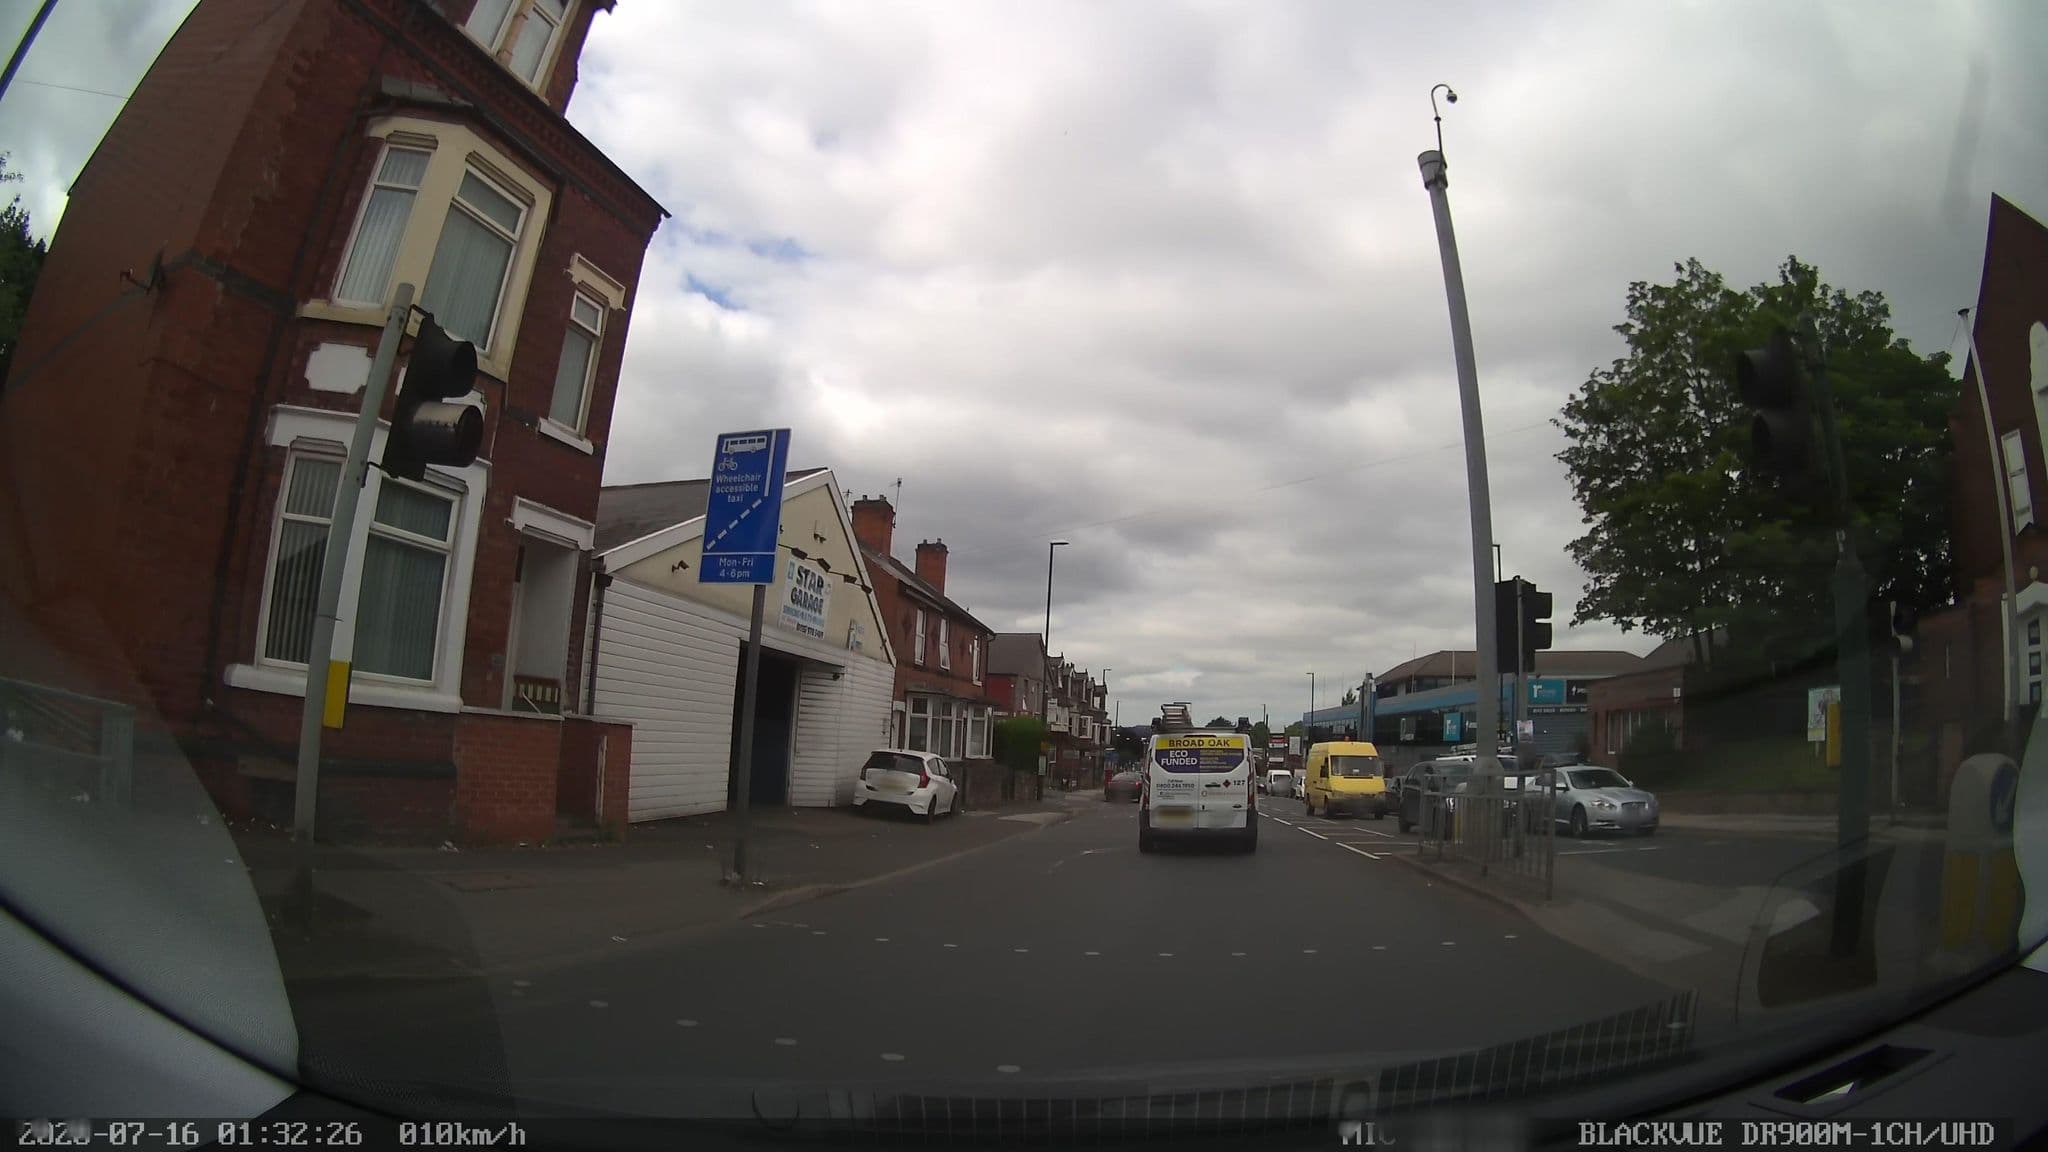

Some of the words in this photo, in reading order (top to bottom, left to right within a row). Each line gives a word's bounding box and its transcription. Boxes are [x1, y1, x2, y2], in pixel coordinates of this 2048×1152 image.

[716, 473, 762, 484] Wheelchair
[715, 483, 759, 494] accessible
[727, 494, 744, 503] taxi
[796, 565, 825, 596] STAR
[790, 587, 824, 615] GARAGE
[1168, 739, 1205, 748] BROAD
[1207, 739, 1231, 748] OAK
[1169, 750, 1188, 758] ECO
[1161, 757, 1198, 766] FUNDED
